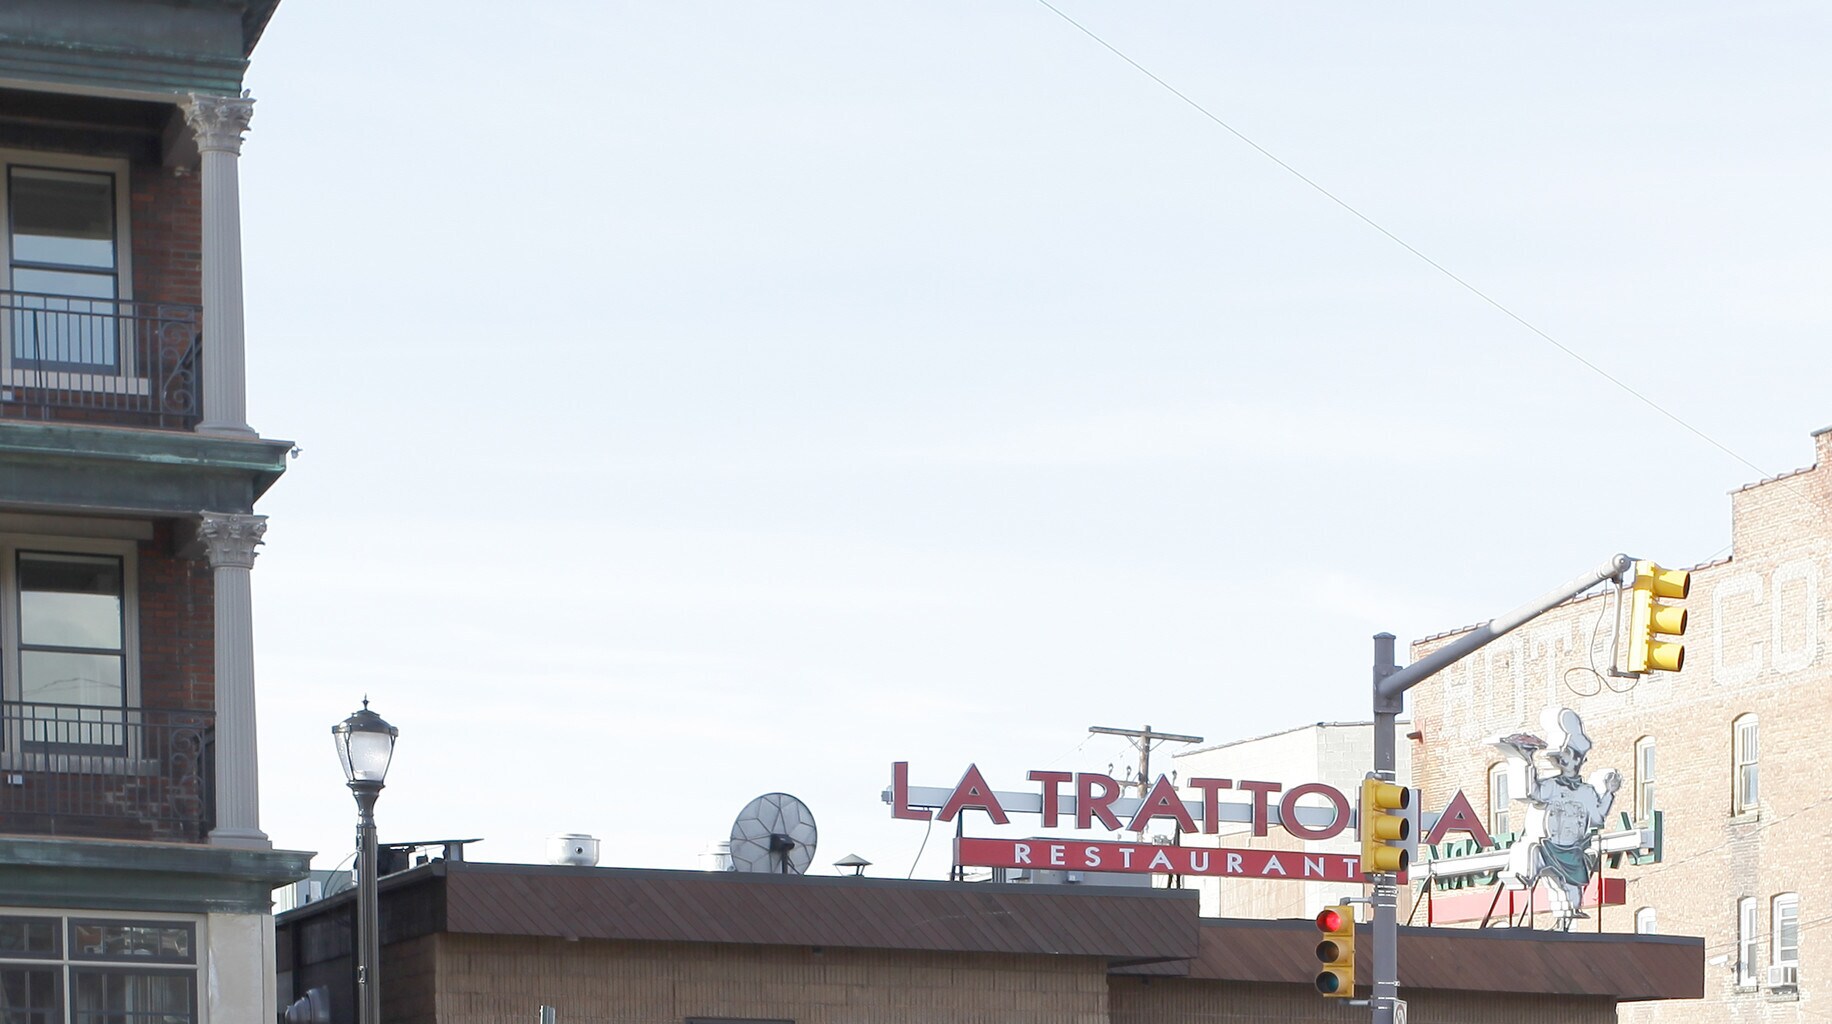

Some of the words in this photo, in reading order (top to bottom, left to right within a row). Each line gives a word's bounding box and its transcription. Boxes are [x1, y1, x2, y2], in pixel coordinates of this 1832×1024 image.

[891, 762, 1010, 824] LA
[1026, 770, 1492, 848] TRATTOA
[1014, 843, 1359, 880] RESTAURANT
